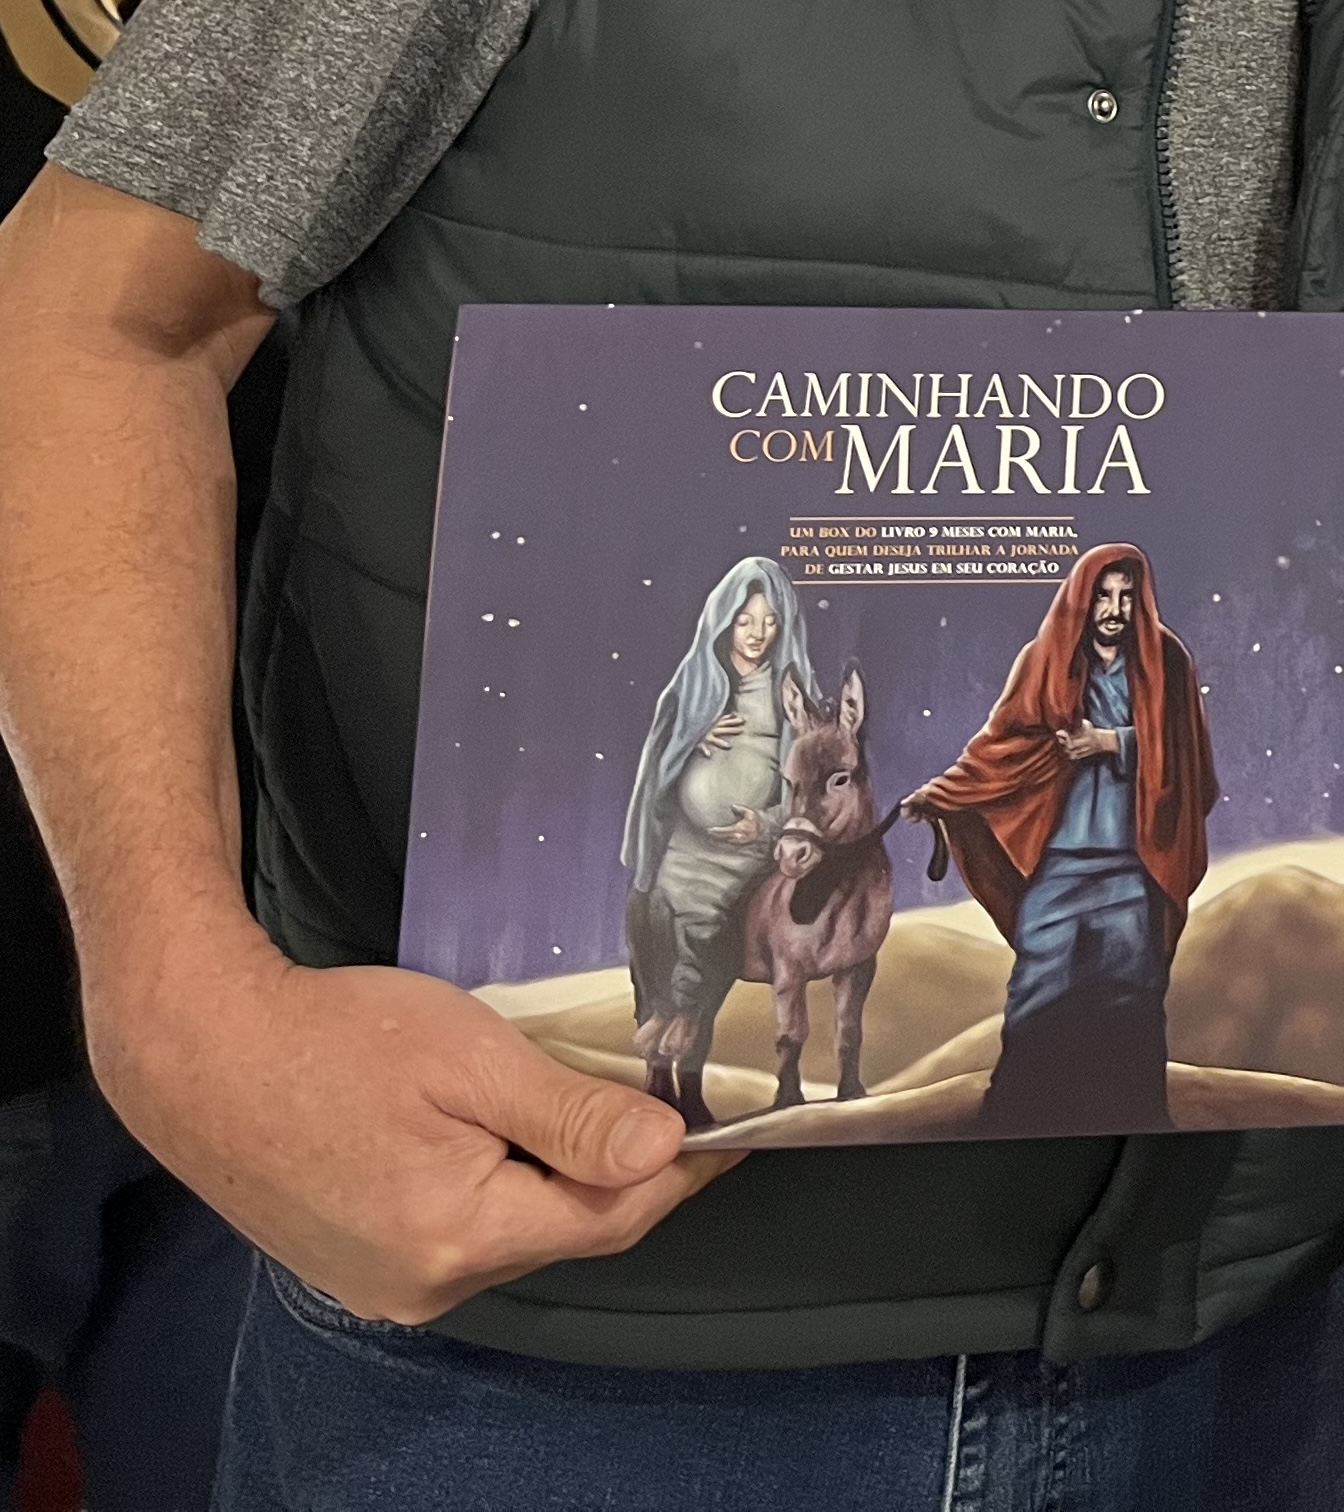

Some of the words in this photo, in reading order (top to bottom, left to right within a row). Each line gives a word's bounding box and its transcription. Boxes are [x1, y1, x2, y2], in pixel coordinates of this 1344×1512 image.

[712, 370, 1165, 420] CAMINHANDO
[729, 429, 834, 462] COM
[834, 424, 1151, 494] MARIA
[790, 526, 814, 538] UM
[818, 526, 850, 538] BOX
[855, 526, 877, 538] DO
[881, 526, 926, 538] LIVRO
[928, 526, 938, 537] 9
[941, 526, 985, 538] MESES
[987, 526, 1021, 538] COM
[780, 545, 819, 557] PARA
[825, 545, 868, 558] QUEM
[873, 545, 922, 557] DESEJA
[926, 544, 992, 556] TRILHAR
[995, 544, 1006, 556] A
[1010, 544, 1079, 557] JORNADA
[804, 563, 825, 574] DE
[828, 563, 884, 575] GESTAR
[887, 562, 928, 576] JESUS
[931, 562, 953, 574] EM
[956, 562, 983, 574] SEU
[986, 560, 1060, 575] CORAÇÃO
